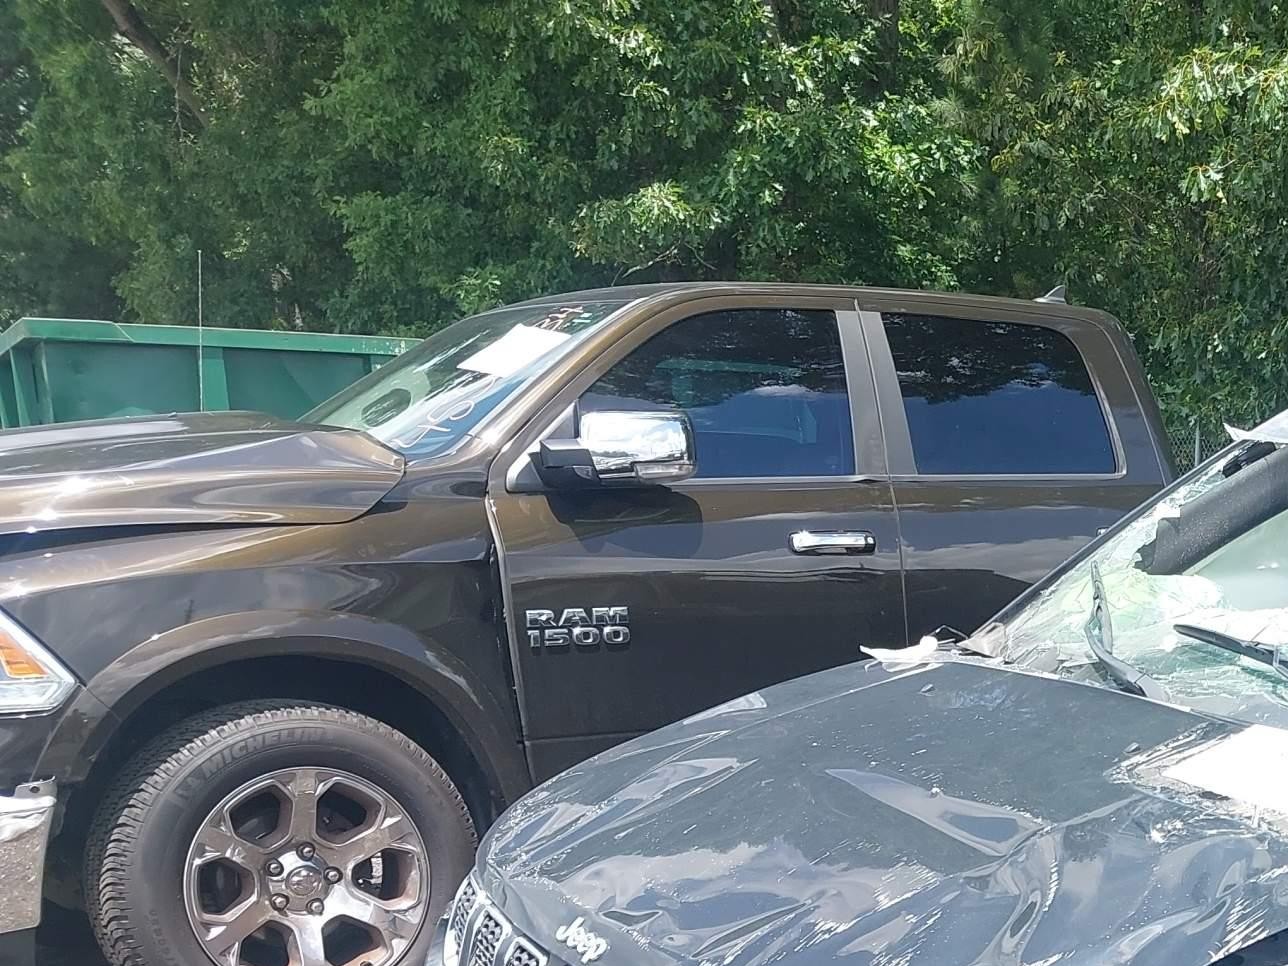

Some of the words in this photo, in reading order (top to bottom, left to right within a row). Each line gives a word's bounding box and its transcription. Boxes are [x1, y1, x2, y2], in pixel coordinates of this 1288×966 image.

[525, 606, 629, 627] RAM
[526, 625, 631, 647] 1500
[555, 916, 608, 965] Jeep
